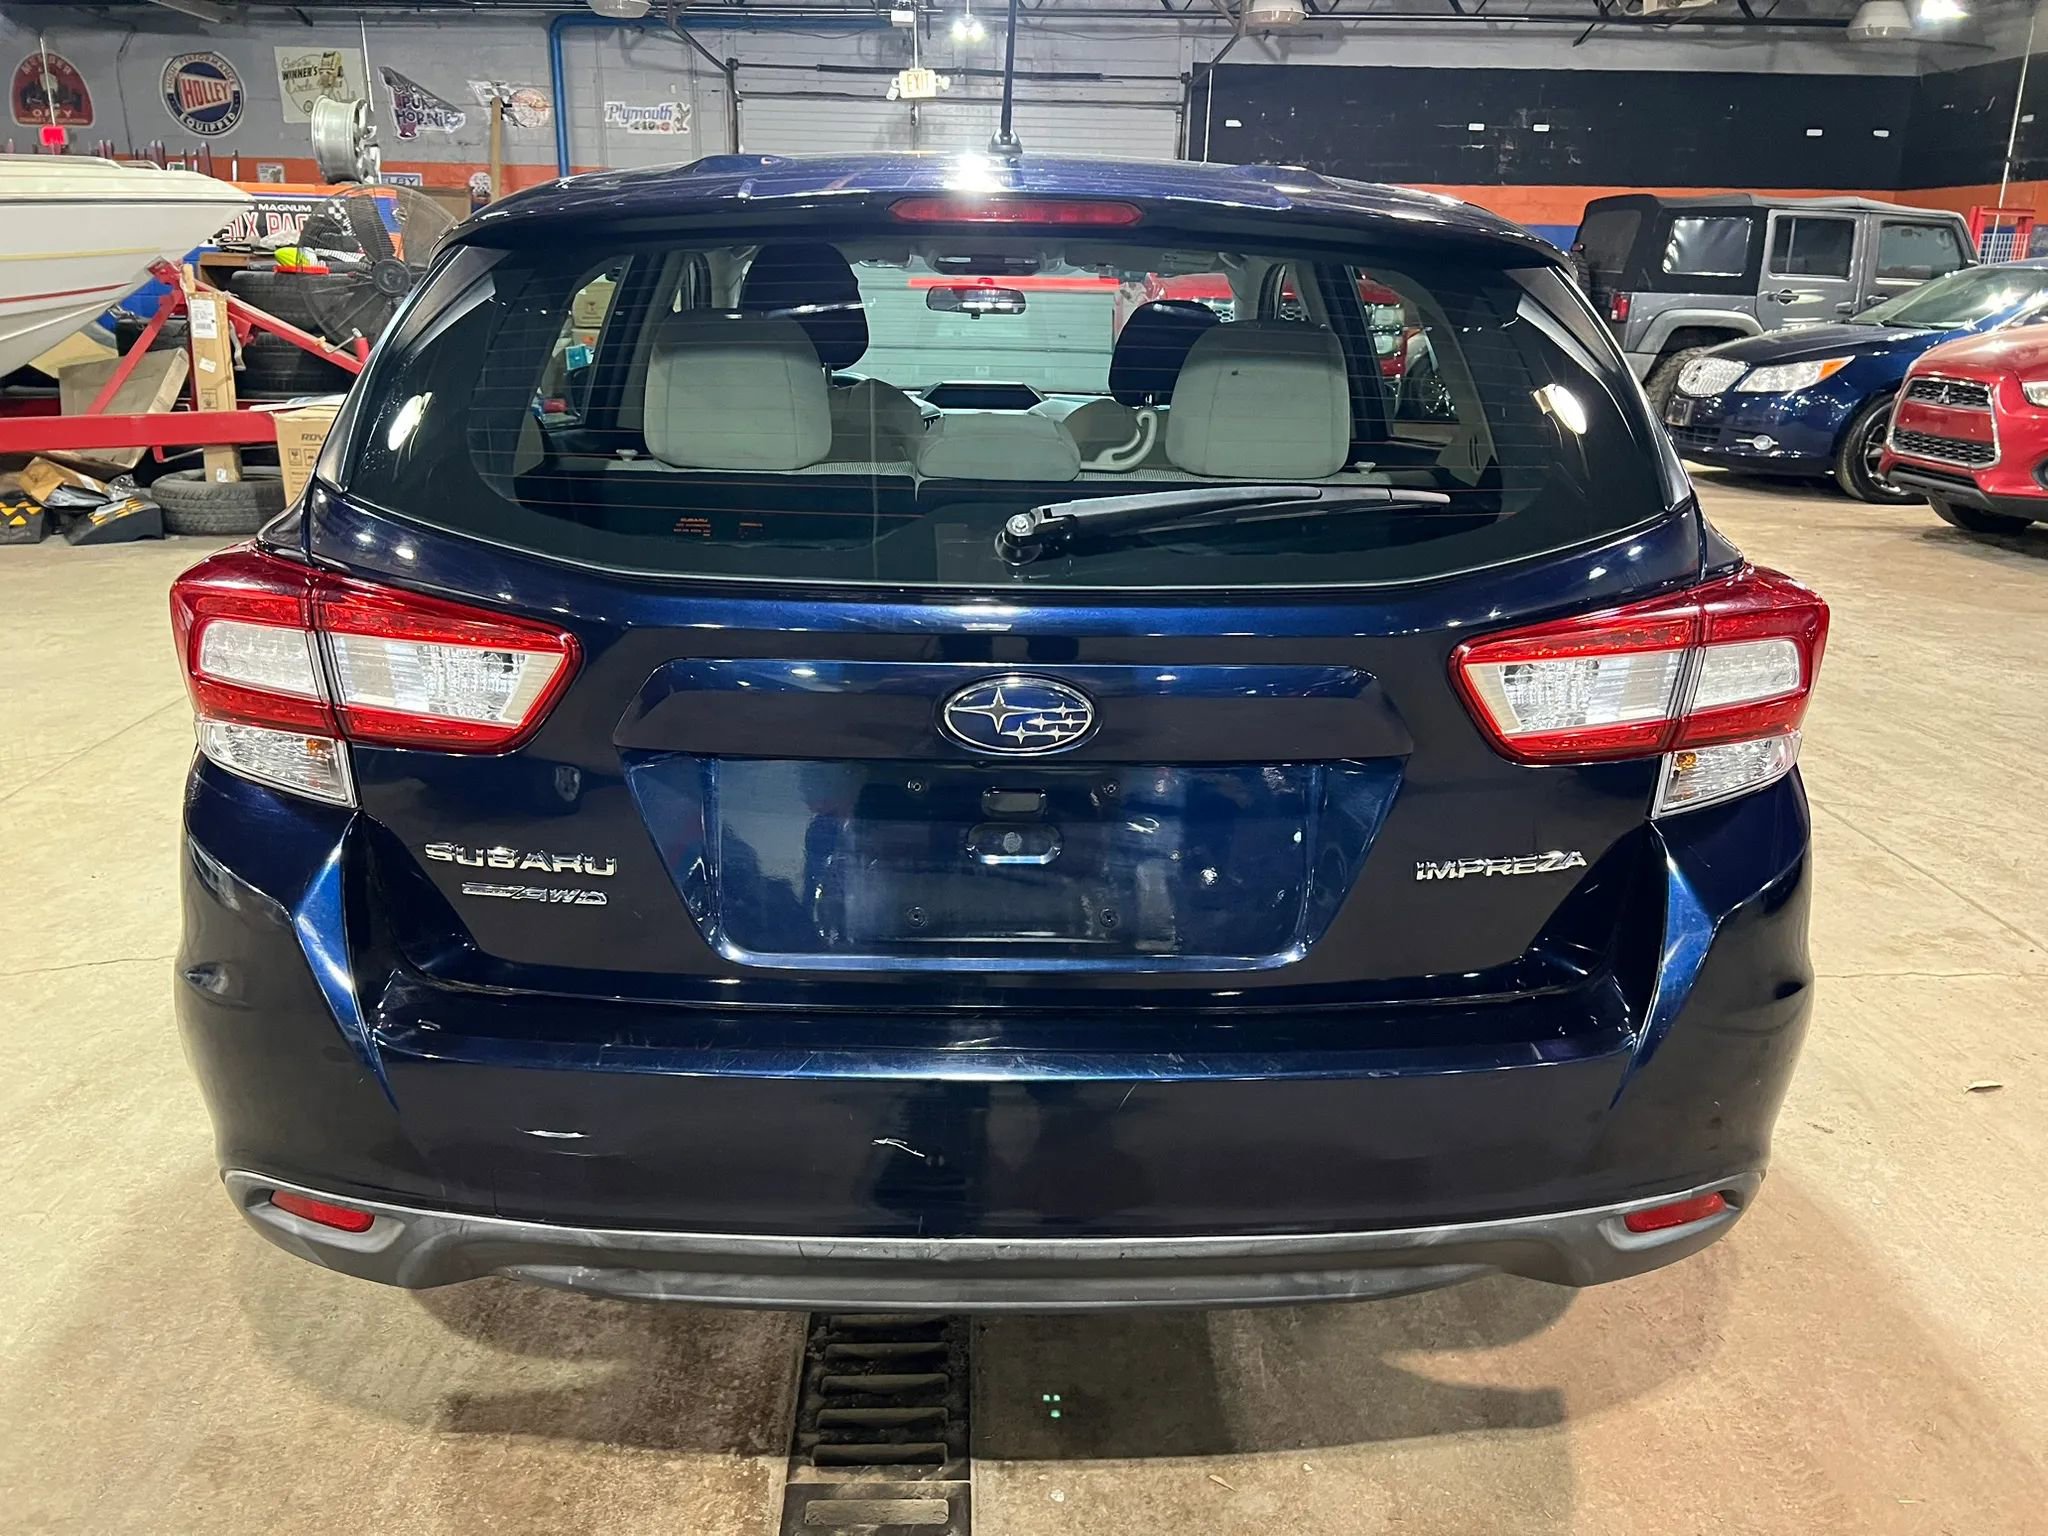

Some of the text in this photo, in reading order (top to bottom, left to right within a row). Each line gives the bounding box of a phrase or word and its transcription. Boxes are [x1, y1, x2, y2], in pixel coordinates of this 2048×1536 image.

[182, 78, 228, 109] HOLLEY
[907, 73, 929, 92] EXIT
[180, 112, 236, 132] EQUIPPED
[606, 103, 673, 125] Plymouth
[258, 203, 312, 212] MAGNUM
[265, 212, 310, 238] PAC
[424, 842, 618, 876] SUBARU
[1415, 850, 1588, 881] IMPREZA
